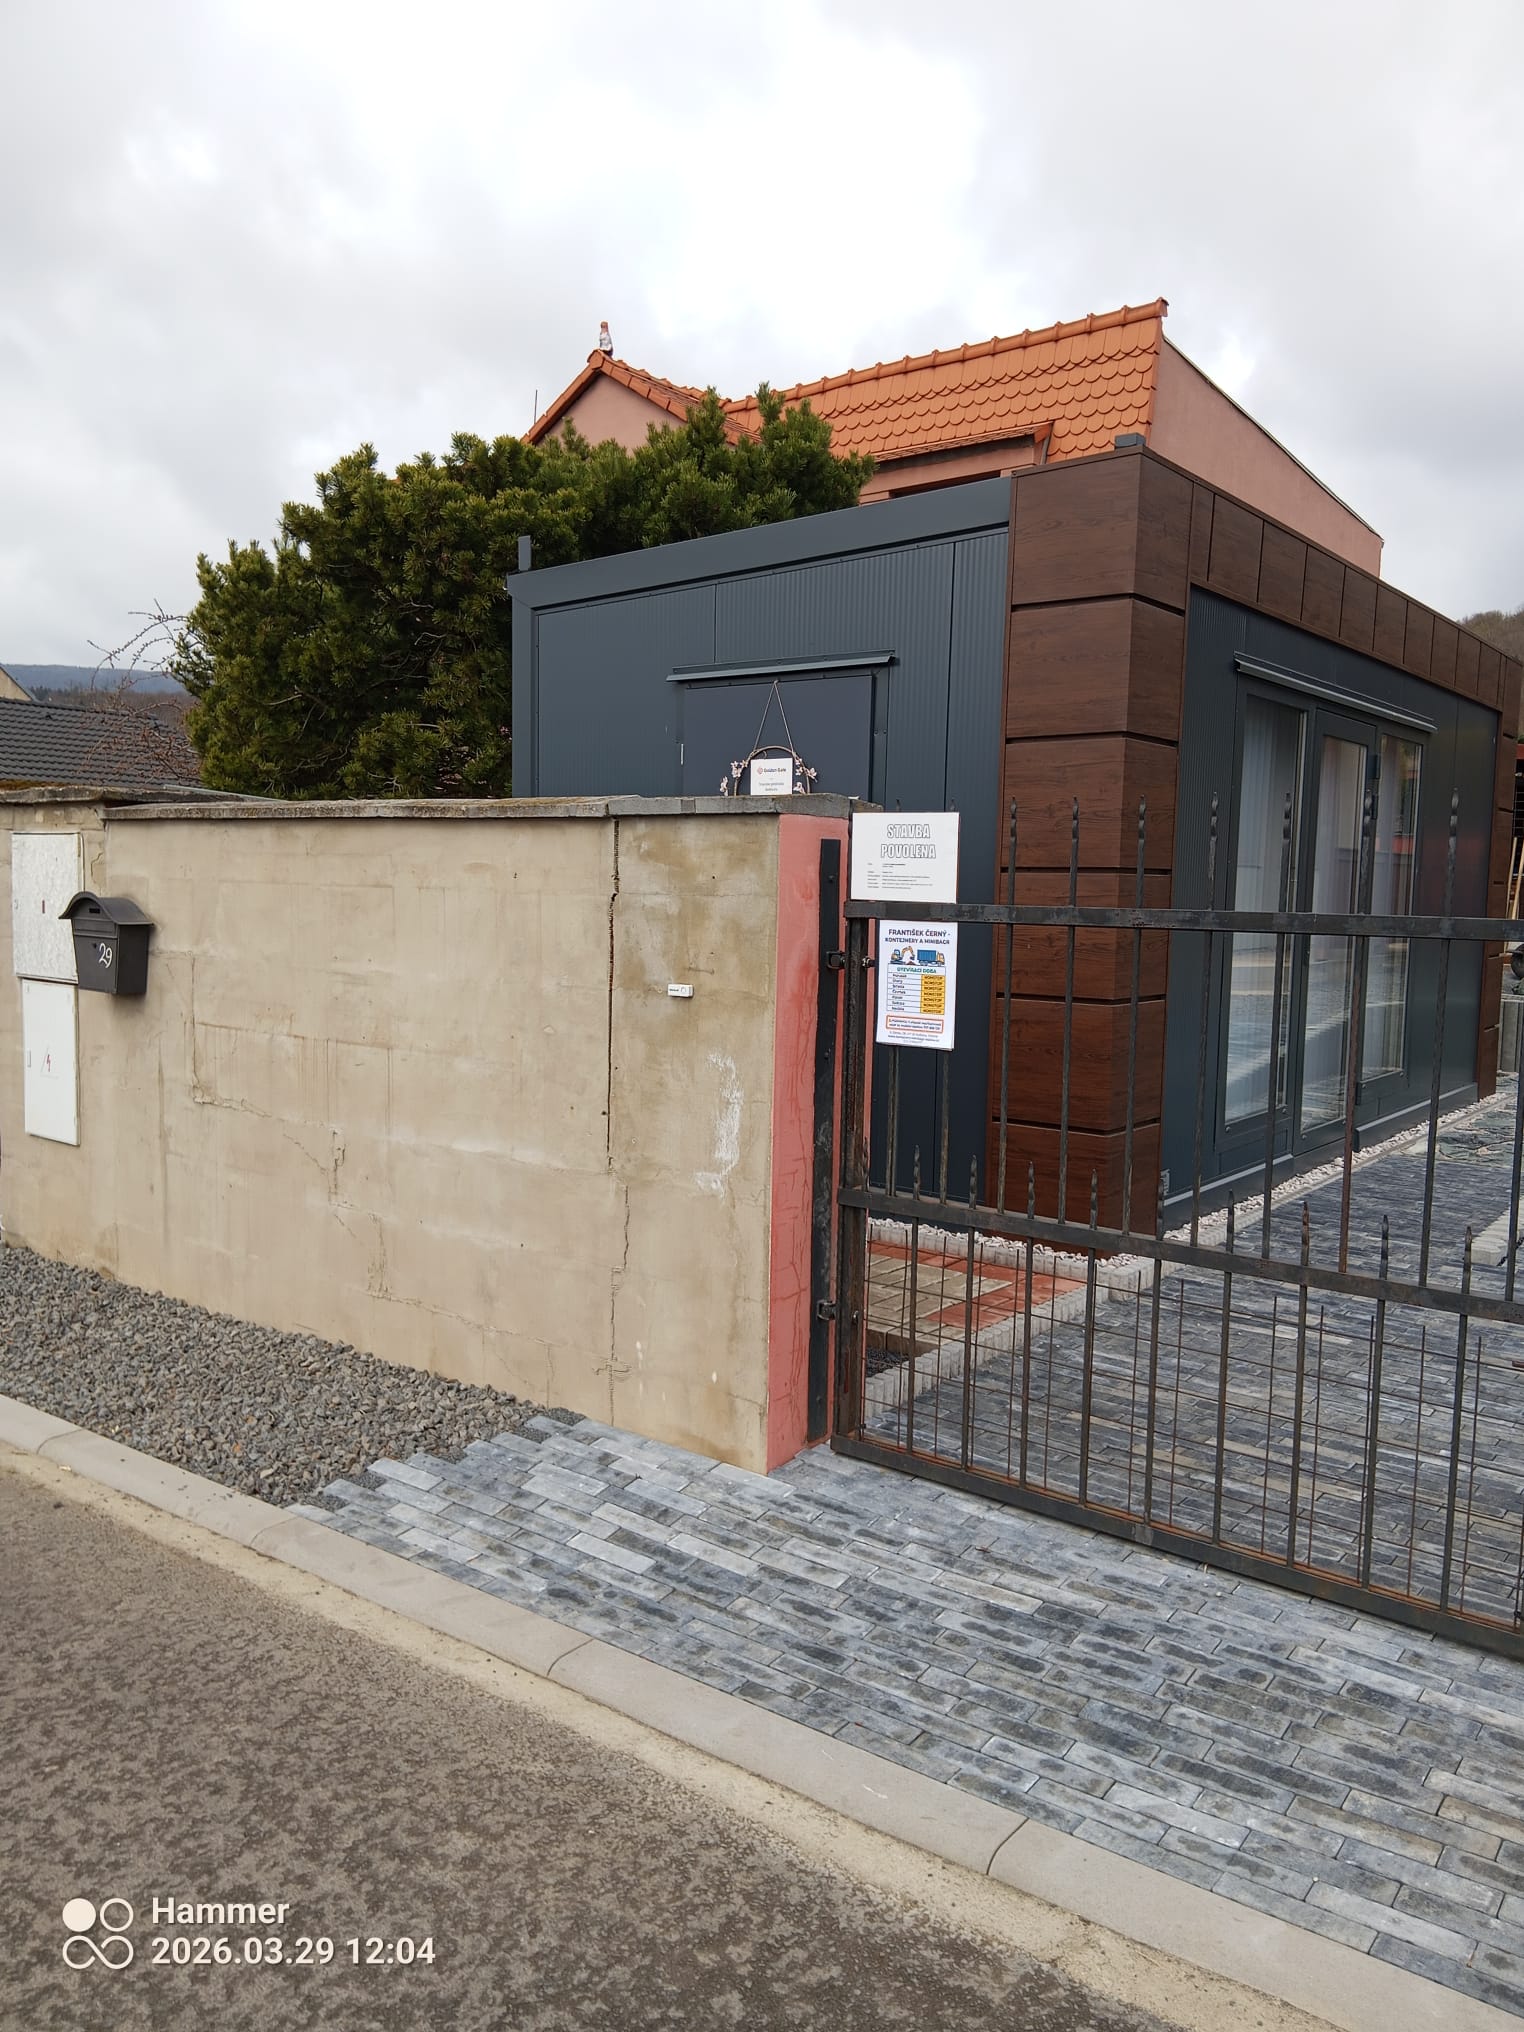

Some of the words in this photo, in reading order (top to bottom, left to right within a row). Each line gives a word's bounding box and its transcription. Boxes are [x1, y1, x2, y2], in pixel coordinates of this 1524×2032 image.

[887, 824, 930, 839] STAVBA
[880, 843, 937, 859] POVOLENA
[888, 929, 924, 937] FRANTIŠEK
[925, 929, 947, 937] ČERNÝ
[98, 942, 112, 969] 29
